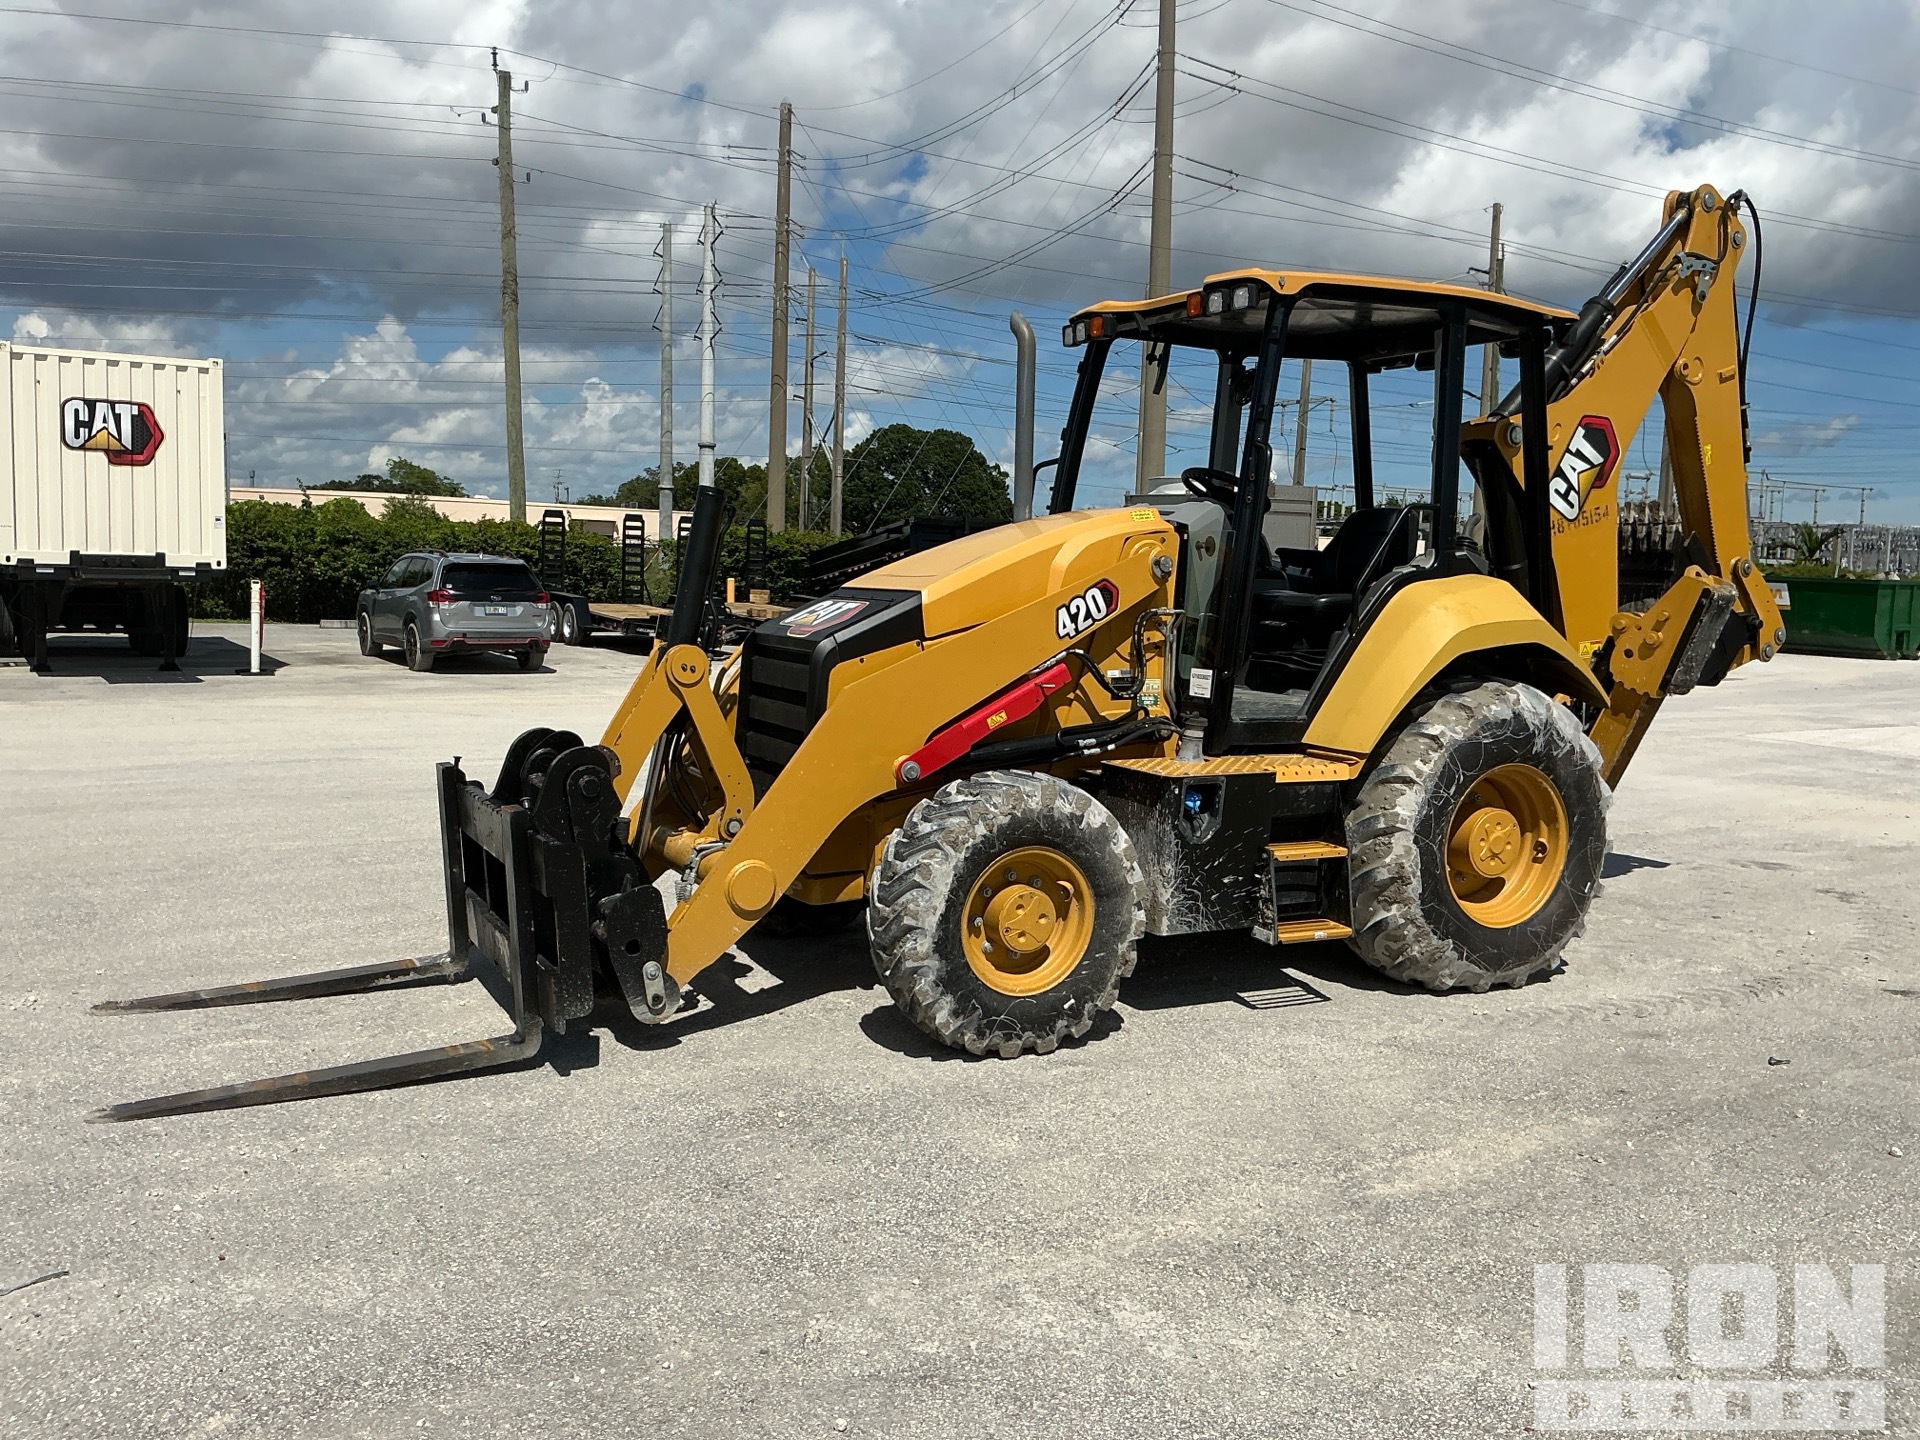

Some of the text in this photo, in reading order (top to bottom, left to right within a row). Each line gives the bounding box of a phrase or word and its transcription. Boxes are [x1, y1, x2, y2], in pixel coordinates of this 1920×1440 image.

[62, 398, 139, 451] CAT
[1548, 424, 1605, 521] CAT
[783, 600, 862, 626] CAT
[1056, 585, 1109, 638] 420
